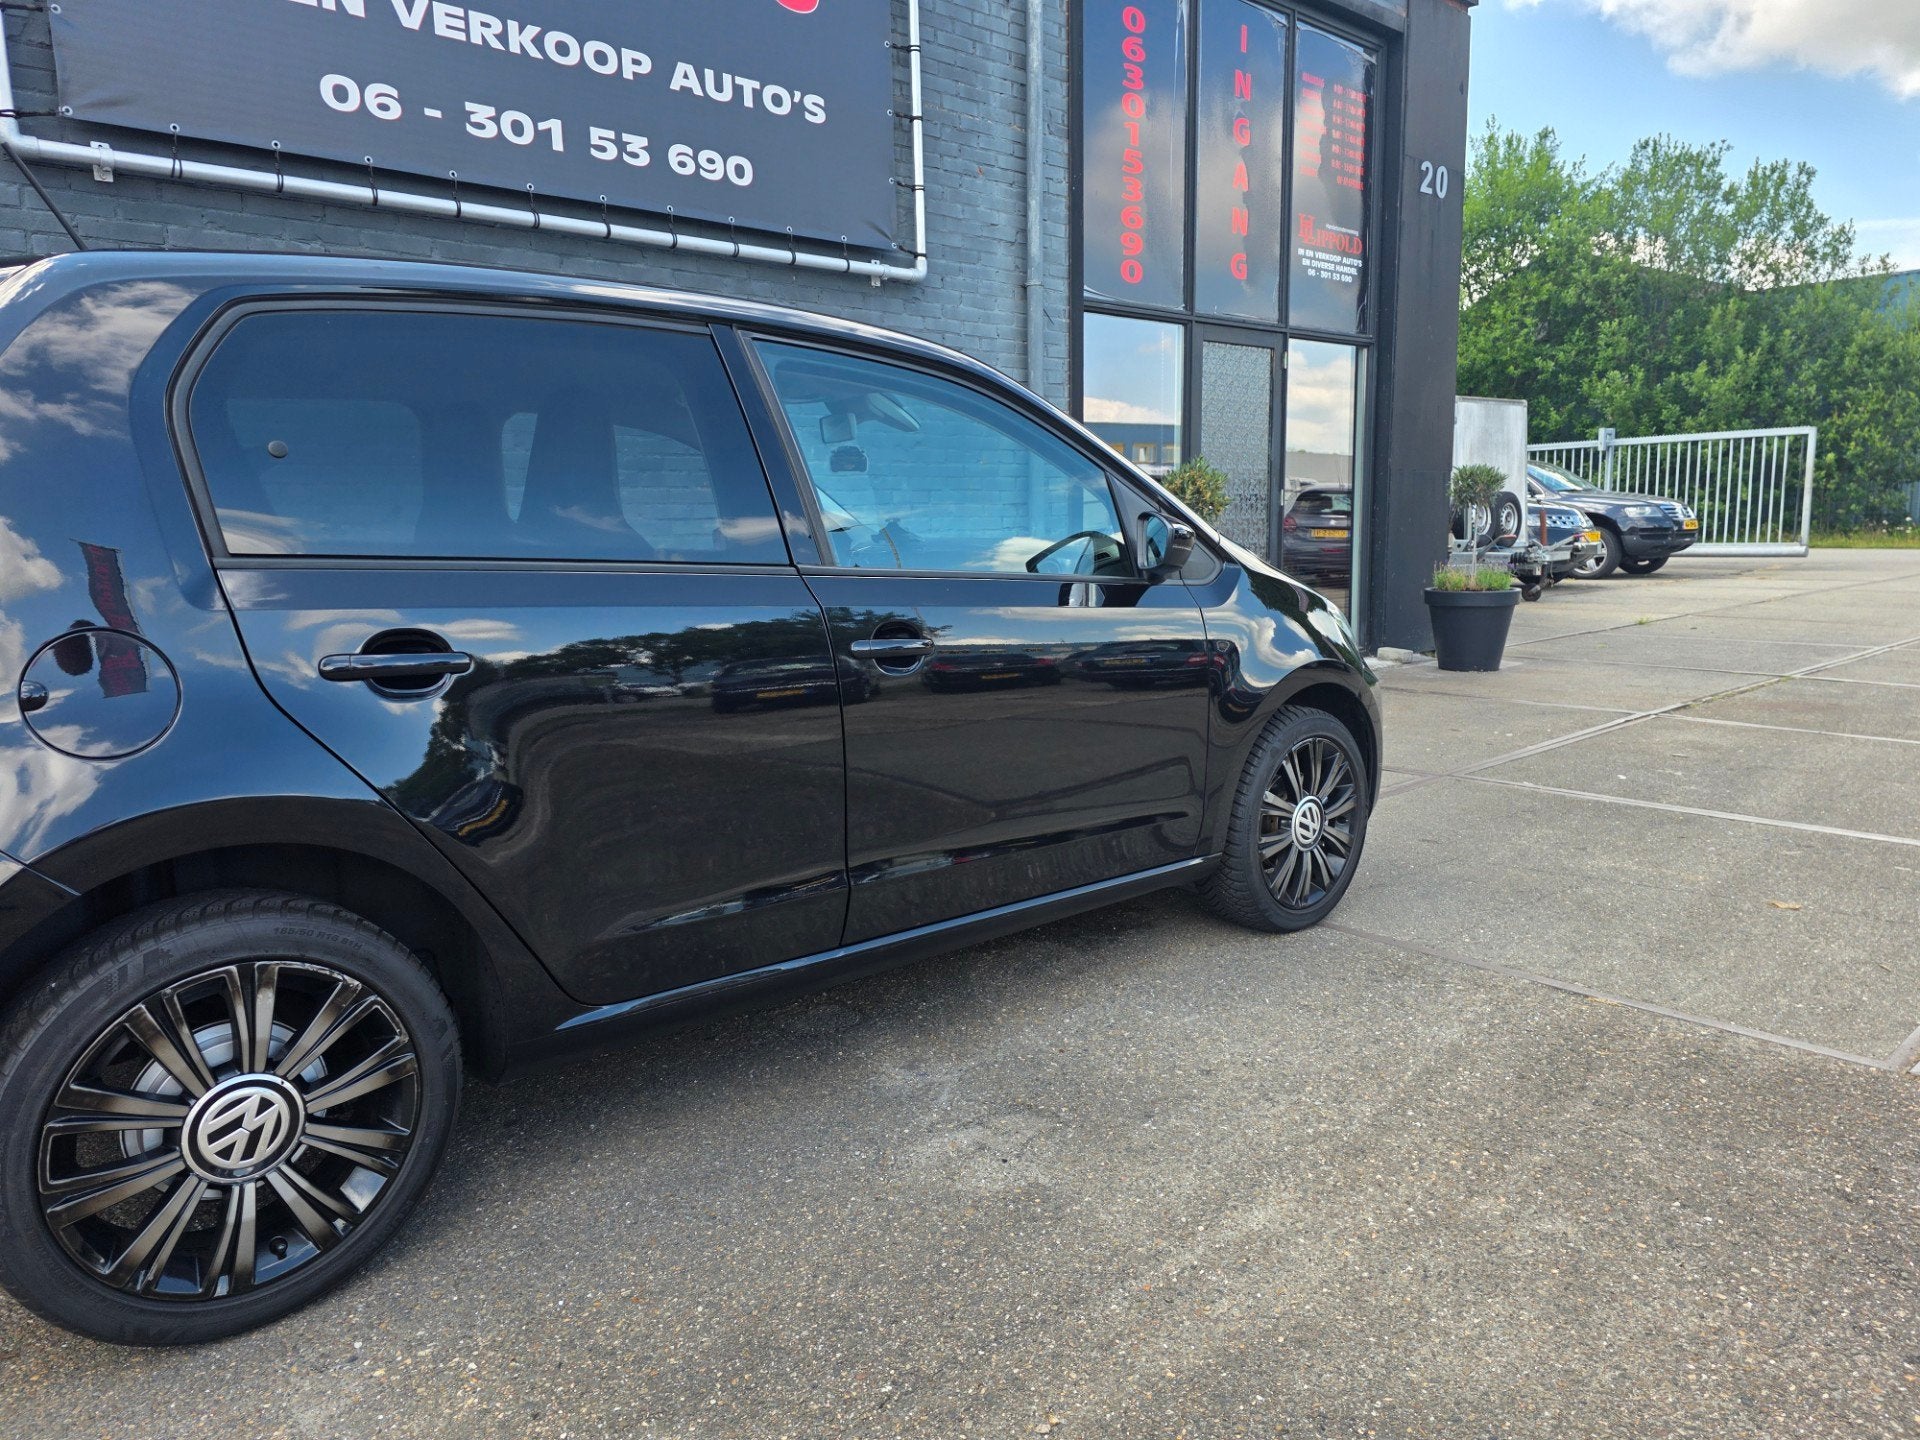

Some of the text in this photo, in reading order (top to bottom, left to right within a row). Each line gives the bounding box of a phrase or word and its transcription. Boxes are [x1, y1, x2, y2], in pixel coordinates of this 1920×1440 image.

[391, 0, 827, 124] VERKOOP AUTO'S
[319, 73, 754, 187] 06 - 301 53 690
[1120, 6, 1146, 284] 0630153690
[1230, 24, 1251, 280] INGANG
[1420, 160, 1449, 199] 20
[1302, 258, 1358, 276] EN DIVERSE HANDEL
[1305, 249, 1314, 258] EN
[1315, 251, 1342, 263] VERKOOP
[1307, 268, 1316, 277] 06
